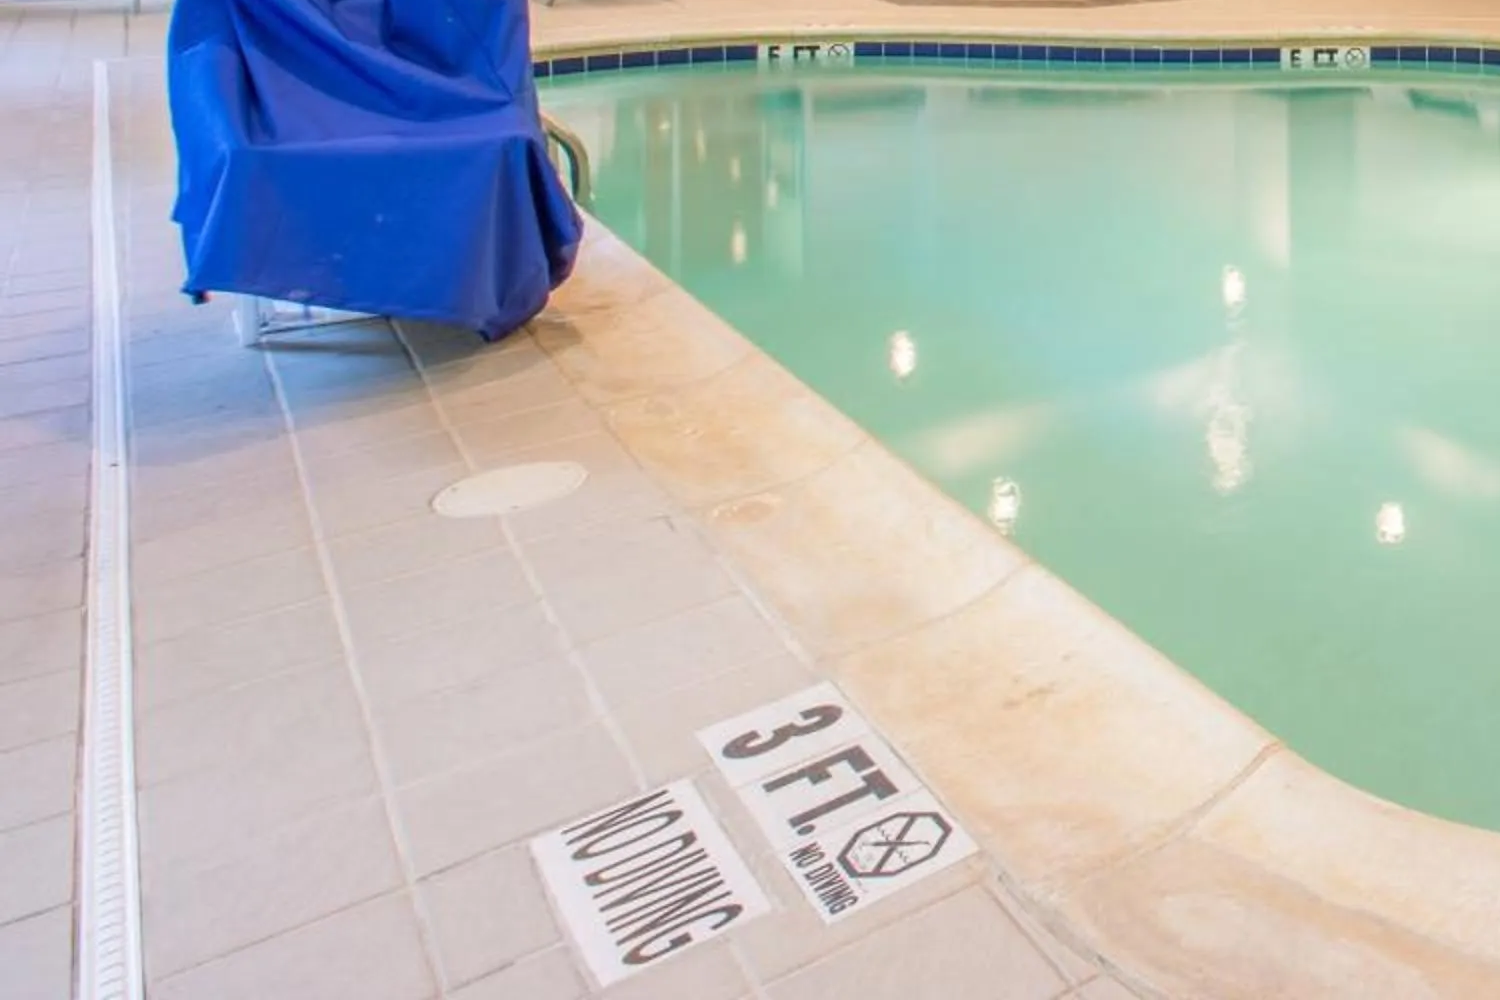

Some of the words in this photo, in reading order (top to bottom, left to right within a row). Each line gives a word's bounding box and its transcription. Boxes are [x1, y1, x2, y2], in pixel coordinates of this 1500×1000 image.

[722, 704, 843, 759] 3
[762, 744, 899, 836] FT.
[561, 789, 684, 861] NO
[789, 841, 825, 868] NO
[583, 830, 743, 965] DIVING
[804, 863, 859, 914] DIVING
